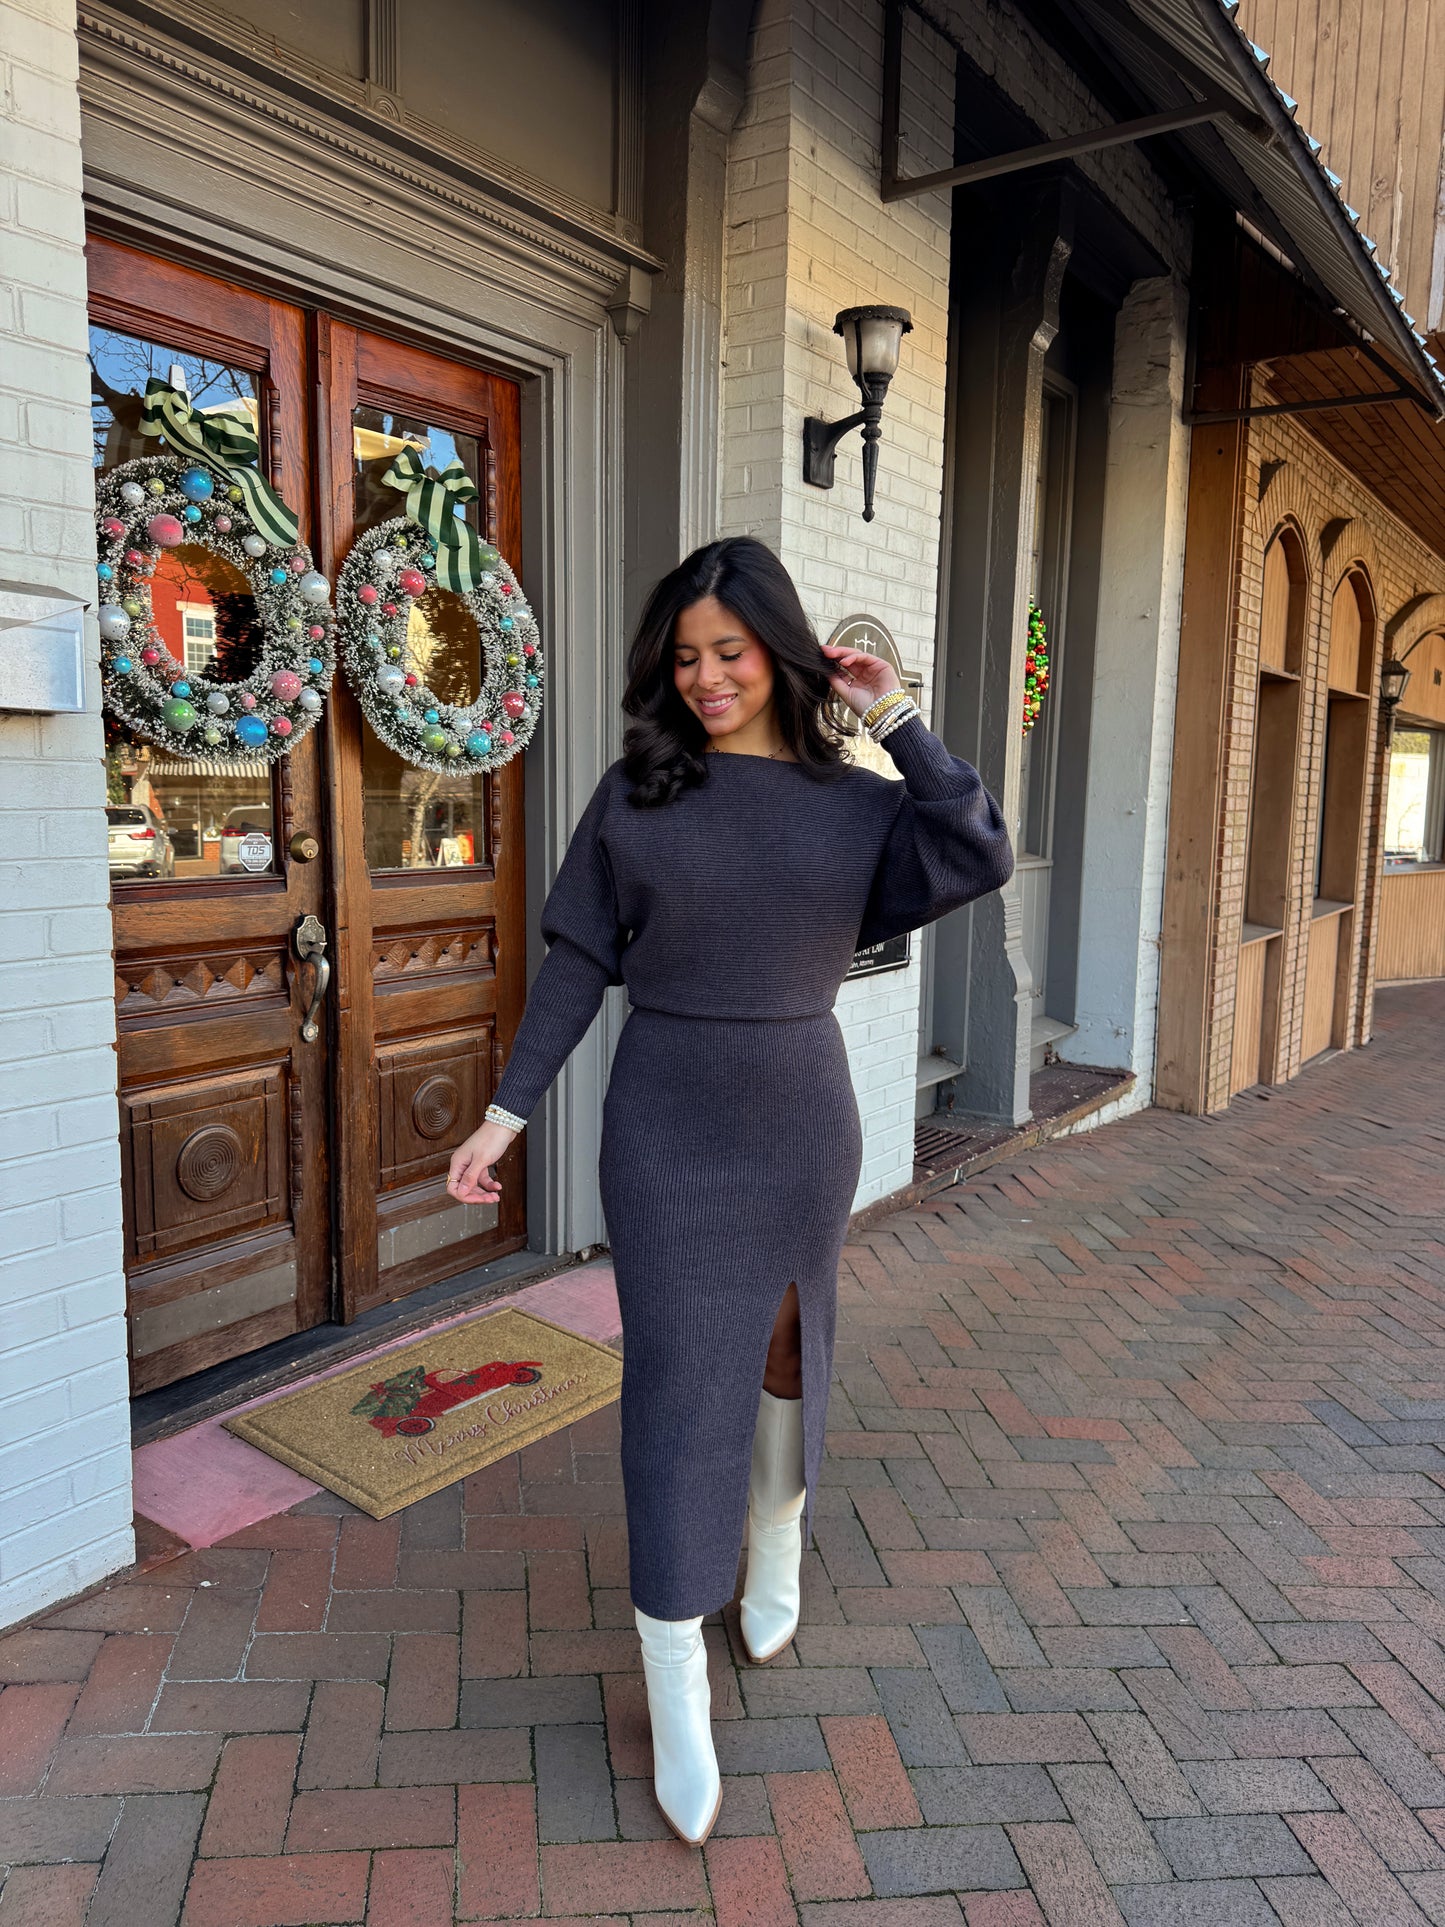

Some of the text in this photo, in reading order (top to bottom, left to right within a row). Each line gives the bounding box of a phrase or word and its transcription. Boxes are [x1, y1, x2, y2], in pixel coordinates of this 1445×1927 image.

[247, 845, 265, 856] TDS
[871, 942, 885, 954] LAW
[392, 1371, 588, 1465] Merry Christmas
